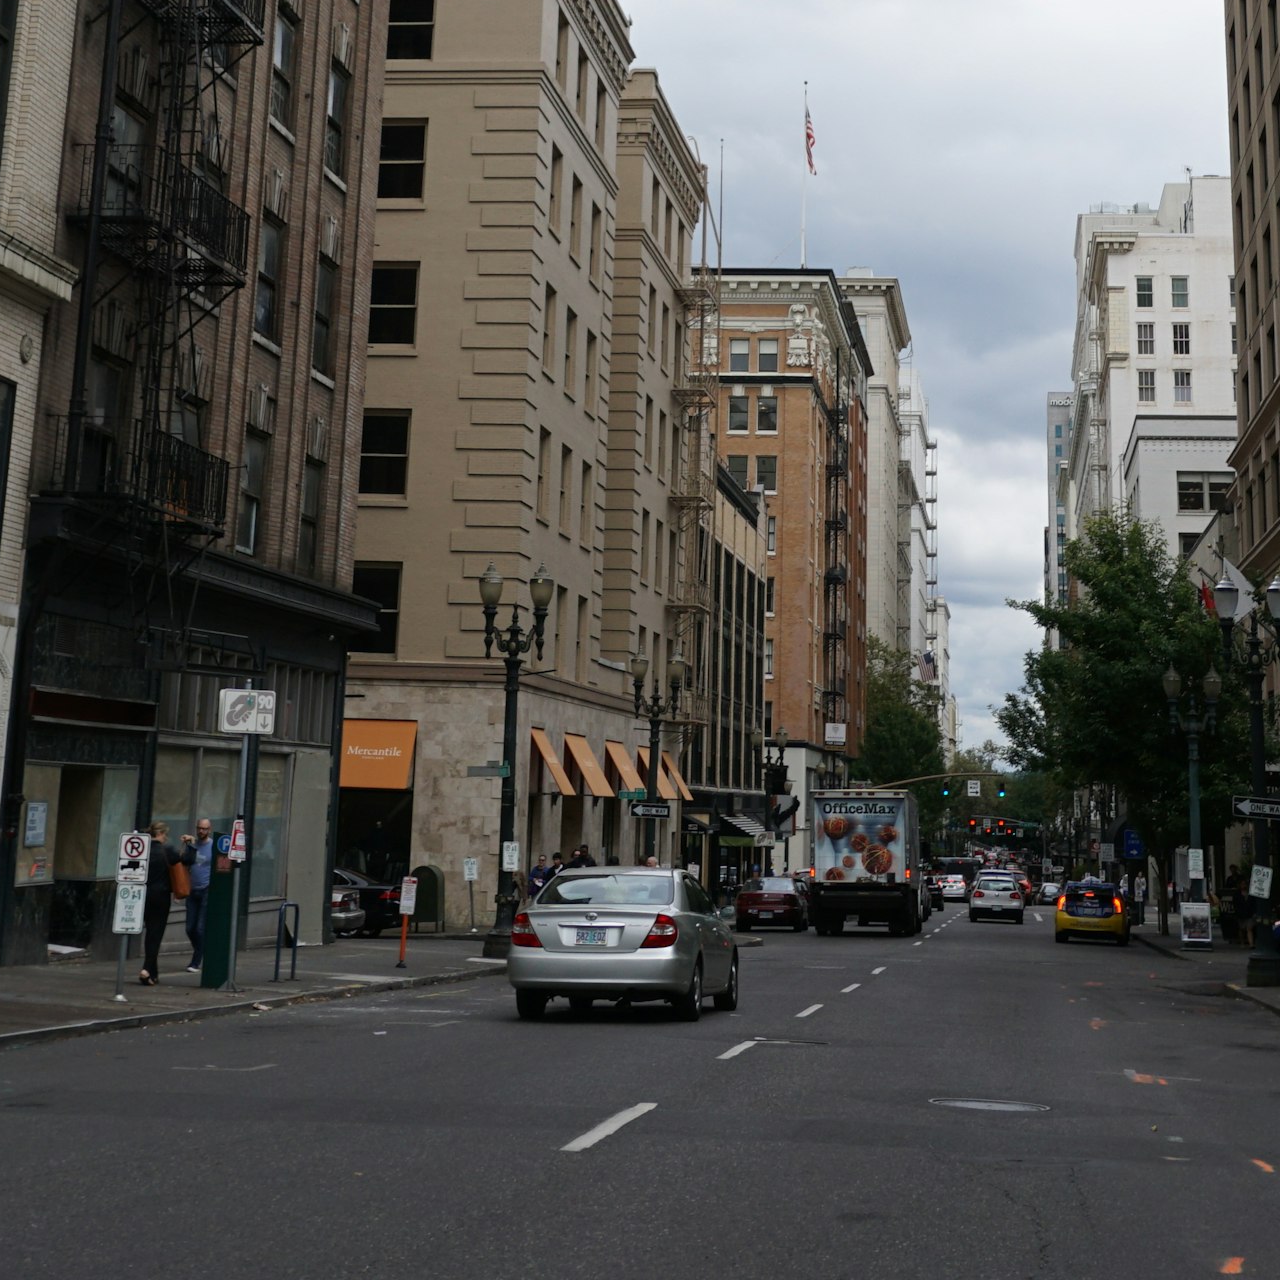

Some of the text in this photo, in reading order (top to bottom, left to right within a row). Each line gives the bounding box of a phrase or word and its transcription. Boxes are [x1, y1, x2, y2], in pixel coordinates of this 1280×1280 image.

[258, 695, 273, 709] 90
[347, 745, 402, 757] Mercantile
[823, 803, 896, 814] OfficeMax
[1250, 804, 1266, 813] ONE
